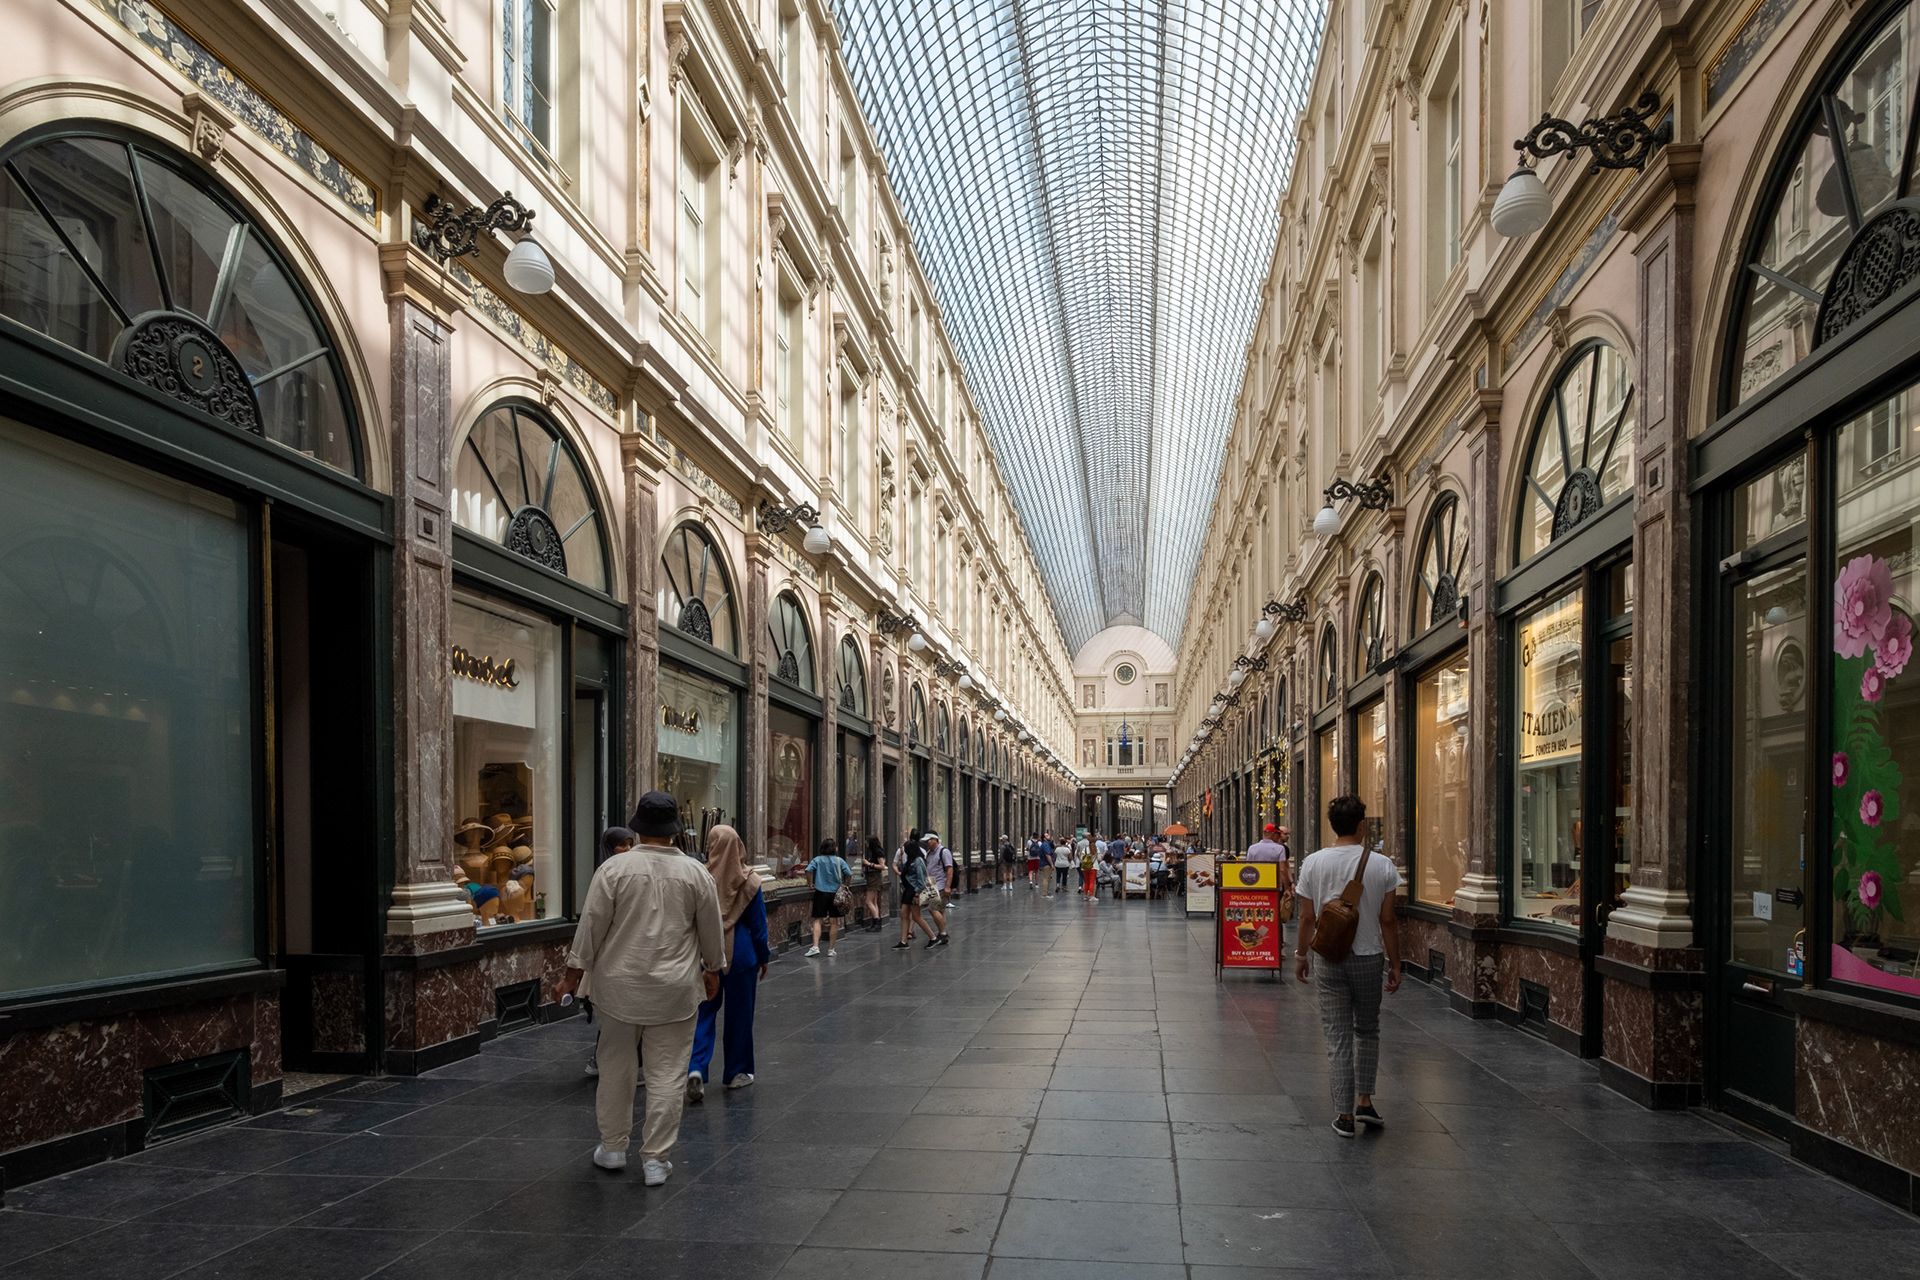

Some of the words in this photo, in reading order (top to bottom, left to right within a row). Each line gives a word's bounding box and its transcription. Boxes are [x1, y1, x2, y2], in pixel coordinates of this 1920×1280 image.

[193, 356, 203, 378] 2
[1535, 741, 1551, 757] FONDÉE
[1551, 741, 1557, 753] EN
[1558, 738, 1568, 751] 1890
